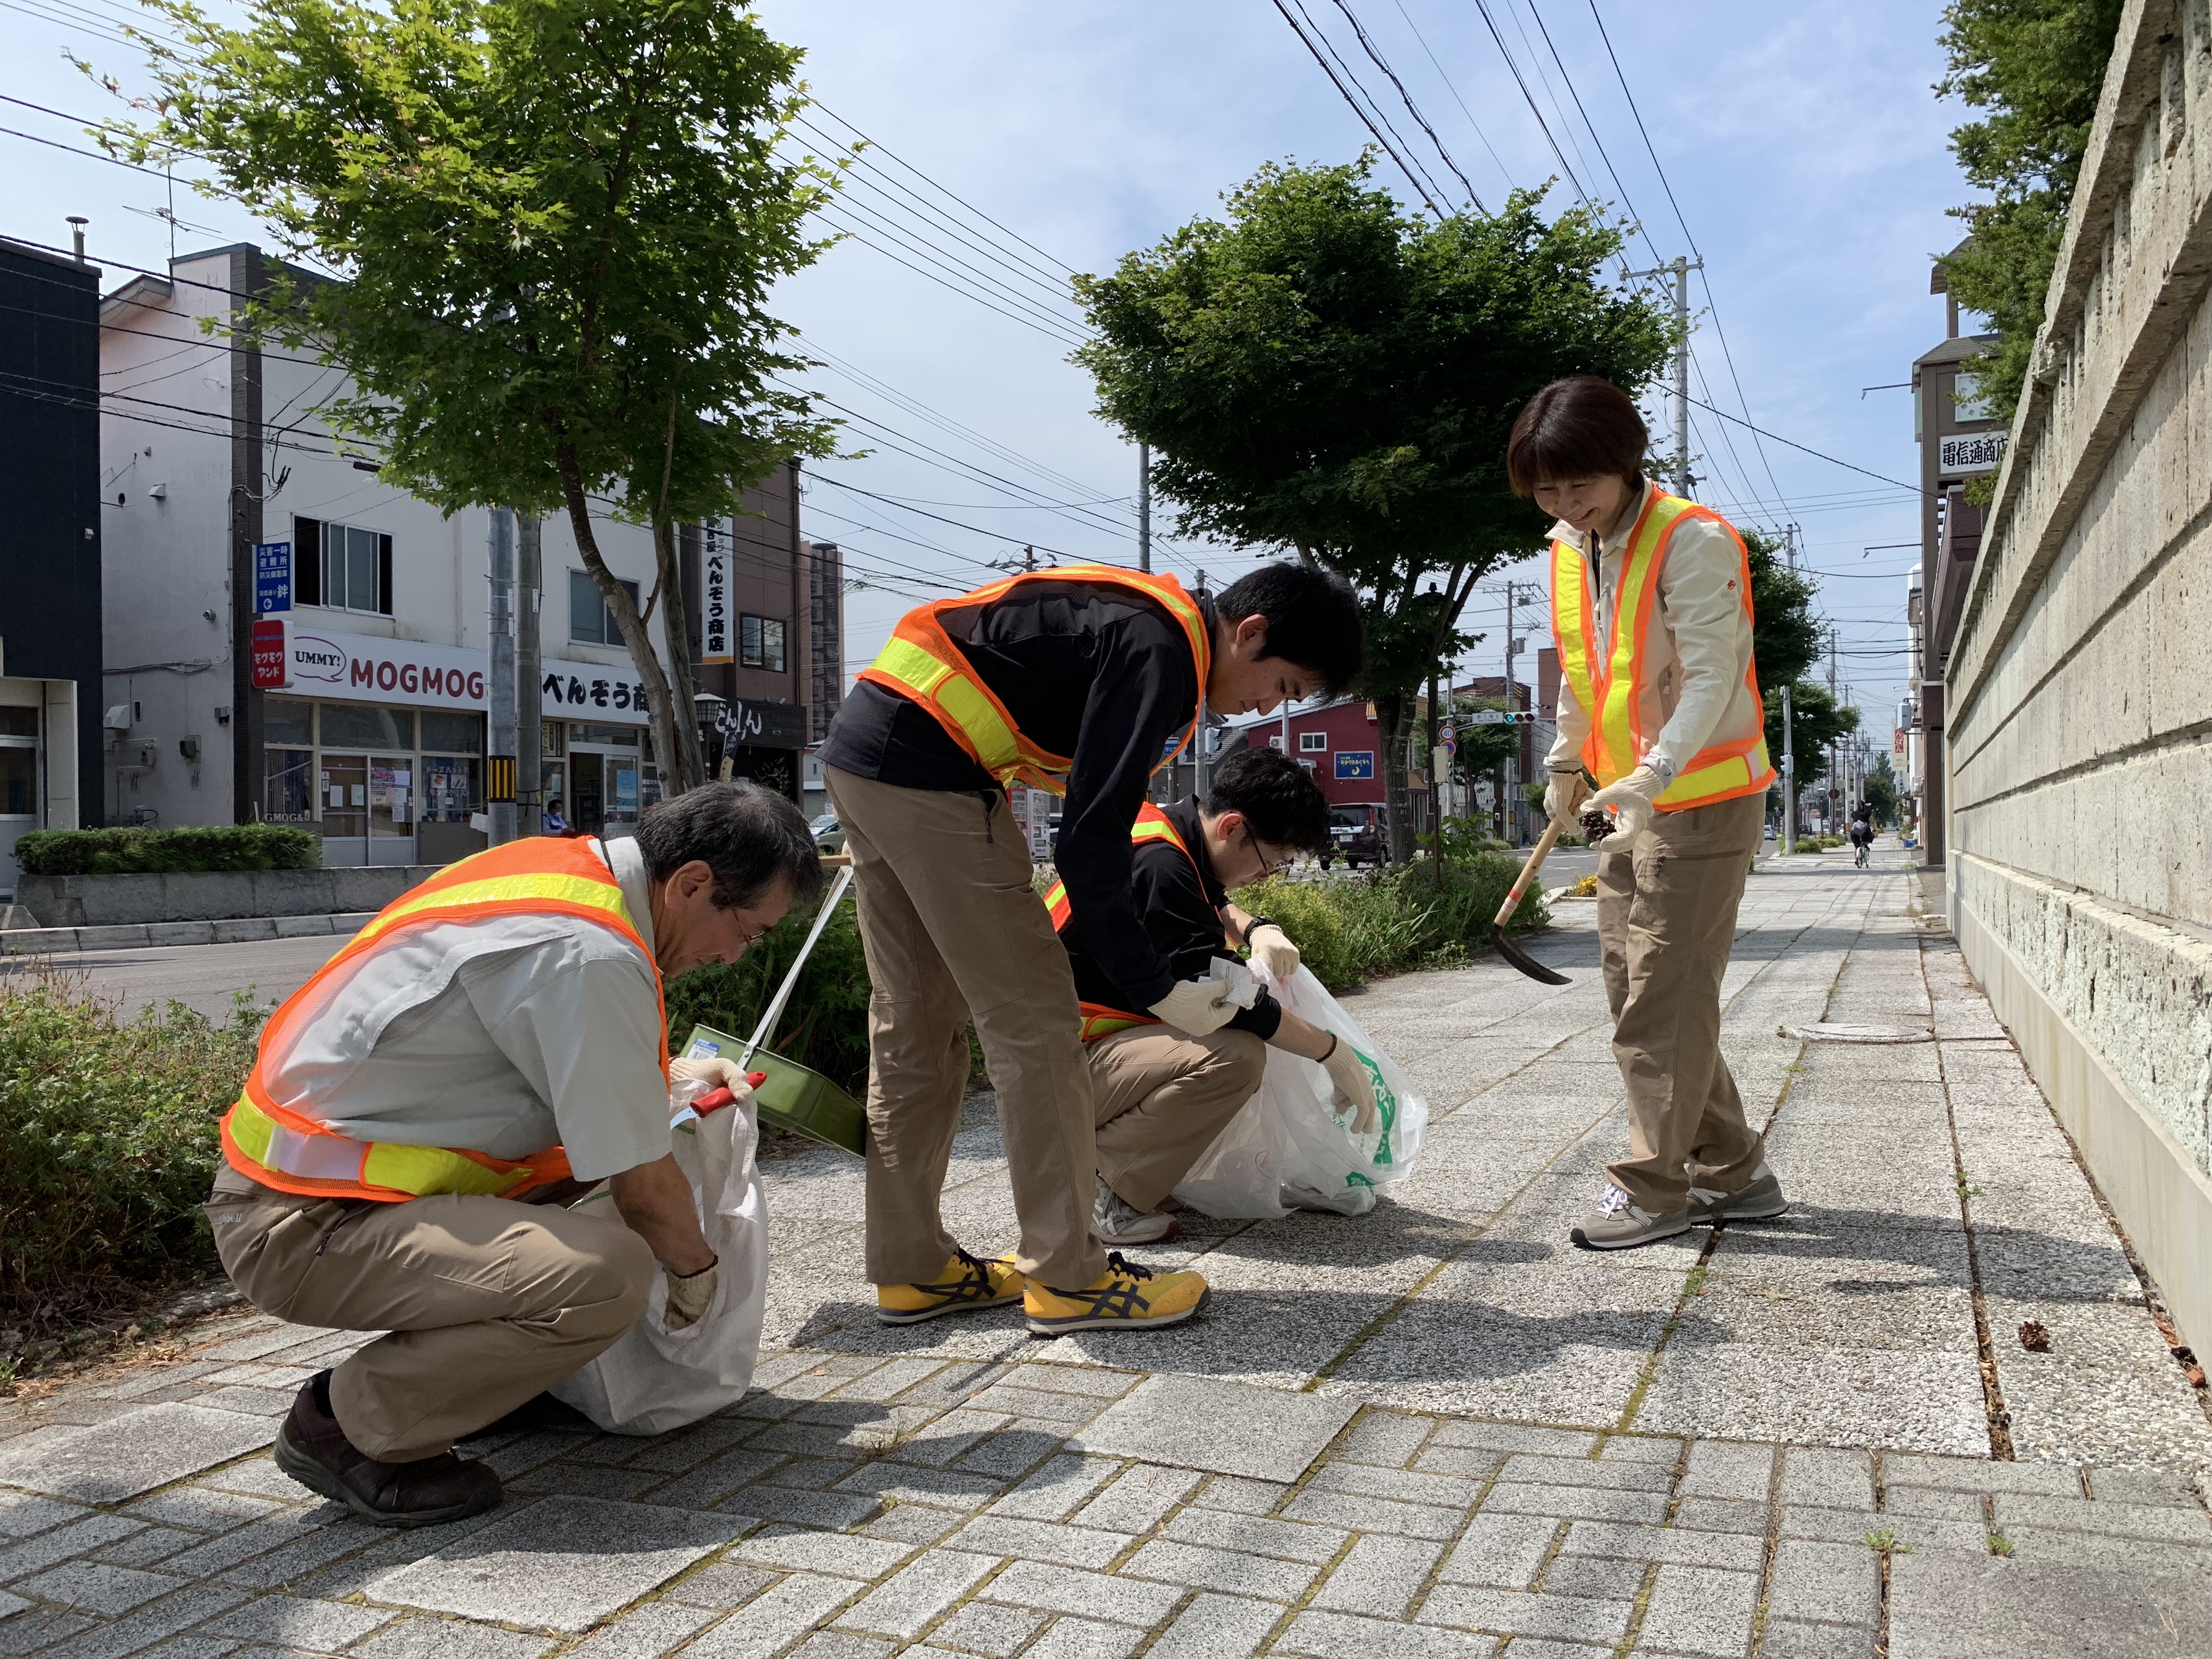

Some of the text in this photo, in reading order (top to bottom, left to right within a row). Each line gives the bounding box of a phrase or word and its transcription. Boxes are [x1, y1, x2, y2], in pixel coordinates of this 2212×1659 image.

[708, 556, 725, 652] べんぞう商店
[258, 666, 280, 678] アンド
[351, 658, 484, 700] MOGMOG
